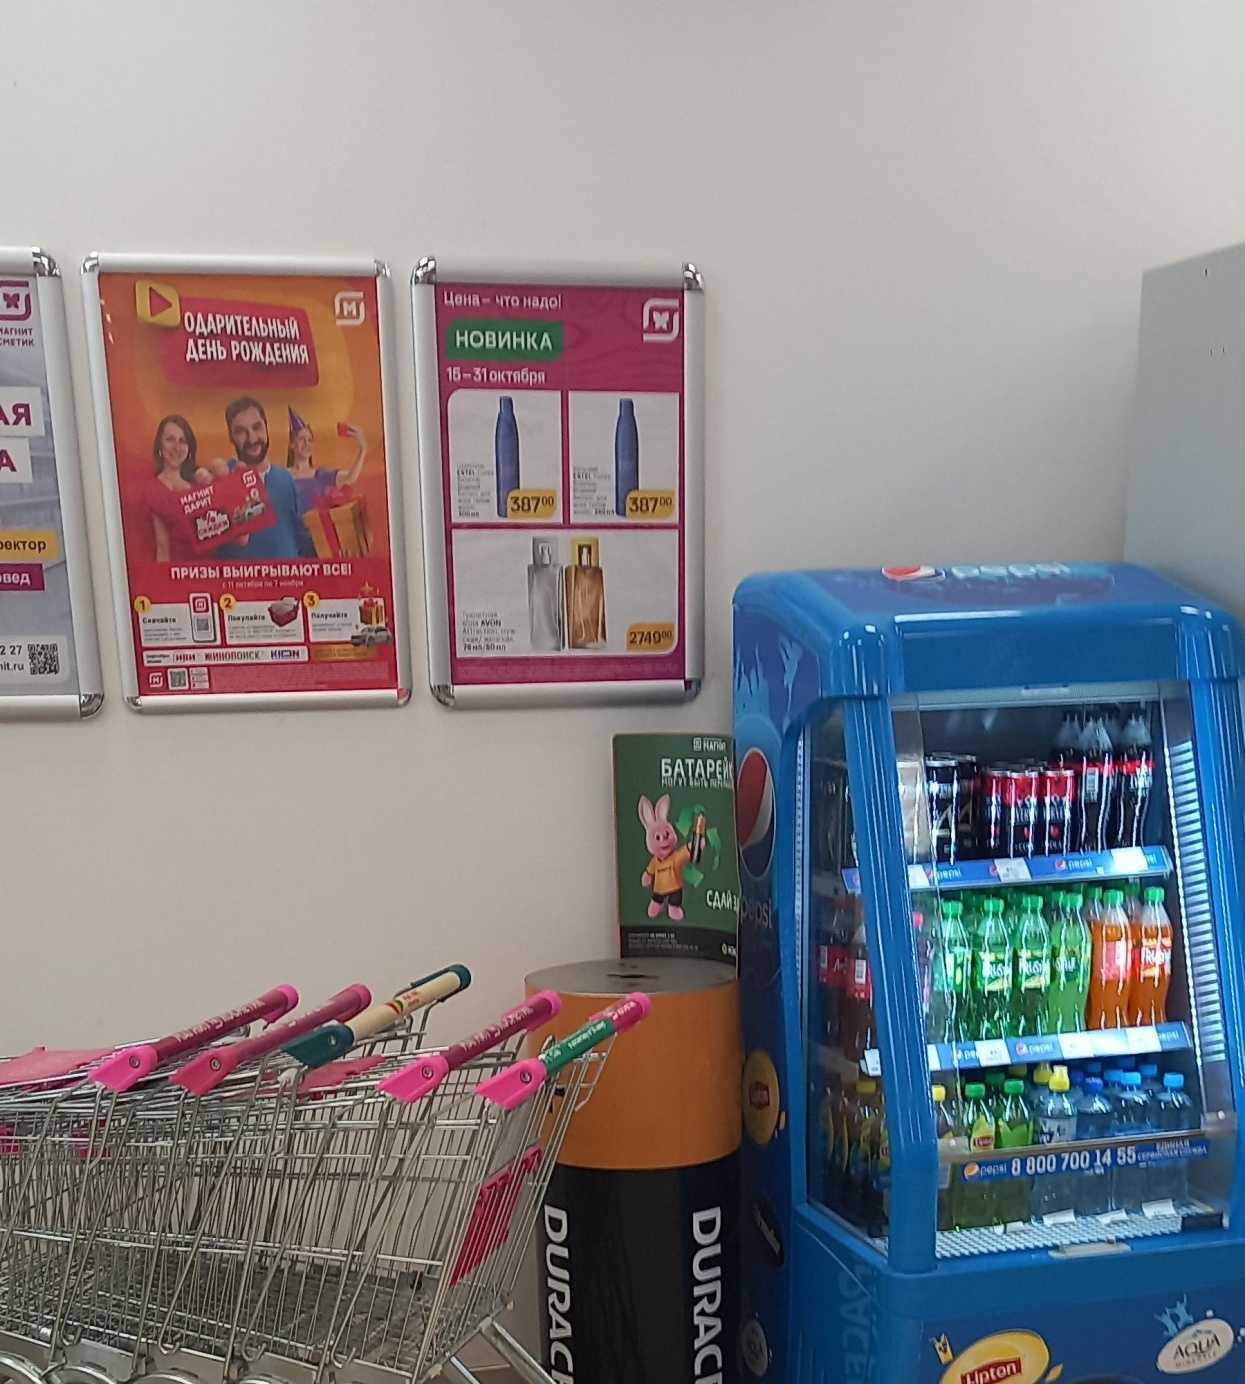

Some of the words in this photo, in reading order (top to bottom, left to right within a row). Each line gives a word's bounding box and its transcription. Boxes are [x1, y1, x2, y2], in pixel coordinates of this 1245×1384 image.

[443, 290, 480, 309] Цена
[496, 294, 520, 308] что
[523, 294, 562, 311] надо!
[0, 327, 33, 336] АГНИТ
[184, 311, 300, 340] ОДАРИТЕЛЬНЫЙ
[455, 329, 553, 351] НОВИНКА
[186, 338, 227, 363] ДЕНЬ
[231, 340, 309, 366] РОЖДЕНИЯ
[489, 367, 546, 387] октября
[170, 566, 220, 579] ПРИЗЫ
[223, 563, 320, 579] ВЫИГРЫВАЮТ
[322, 563, 352, 577] ВСЕ!
[10, 644, 23, 657] 27
[980, 1162, 1007, 1178] pepsi
[1011, 1157, 1021, 1177] 8
[1026, 1153, 1057, 1175] 800
[1061, 1149, 1090, 1171] 700
[1095, 1147, 1112, 1168] 14
[1116, 1145, 1137, 1166] 55
[1173, 1334, 1222, 1361] AQUA
